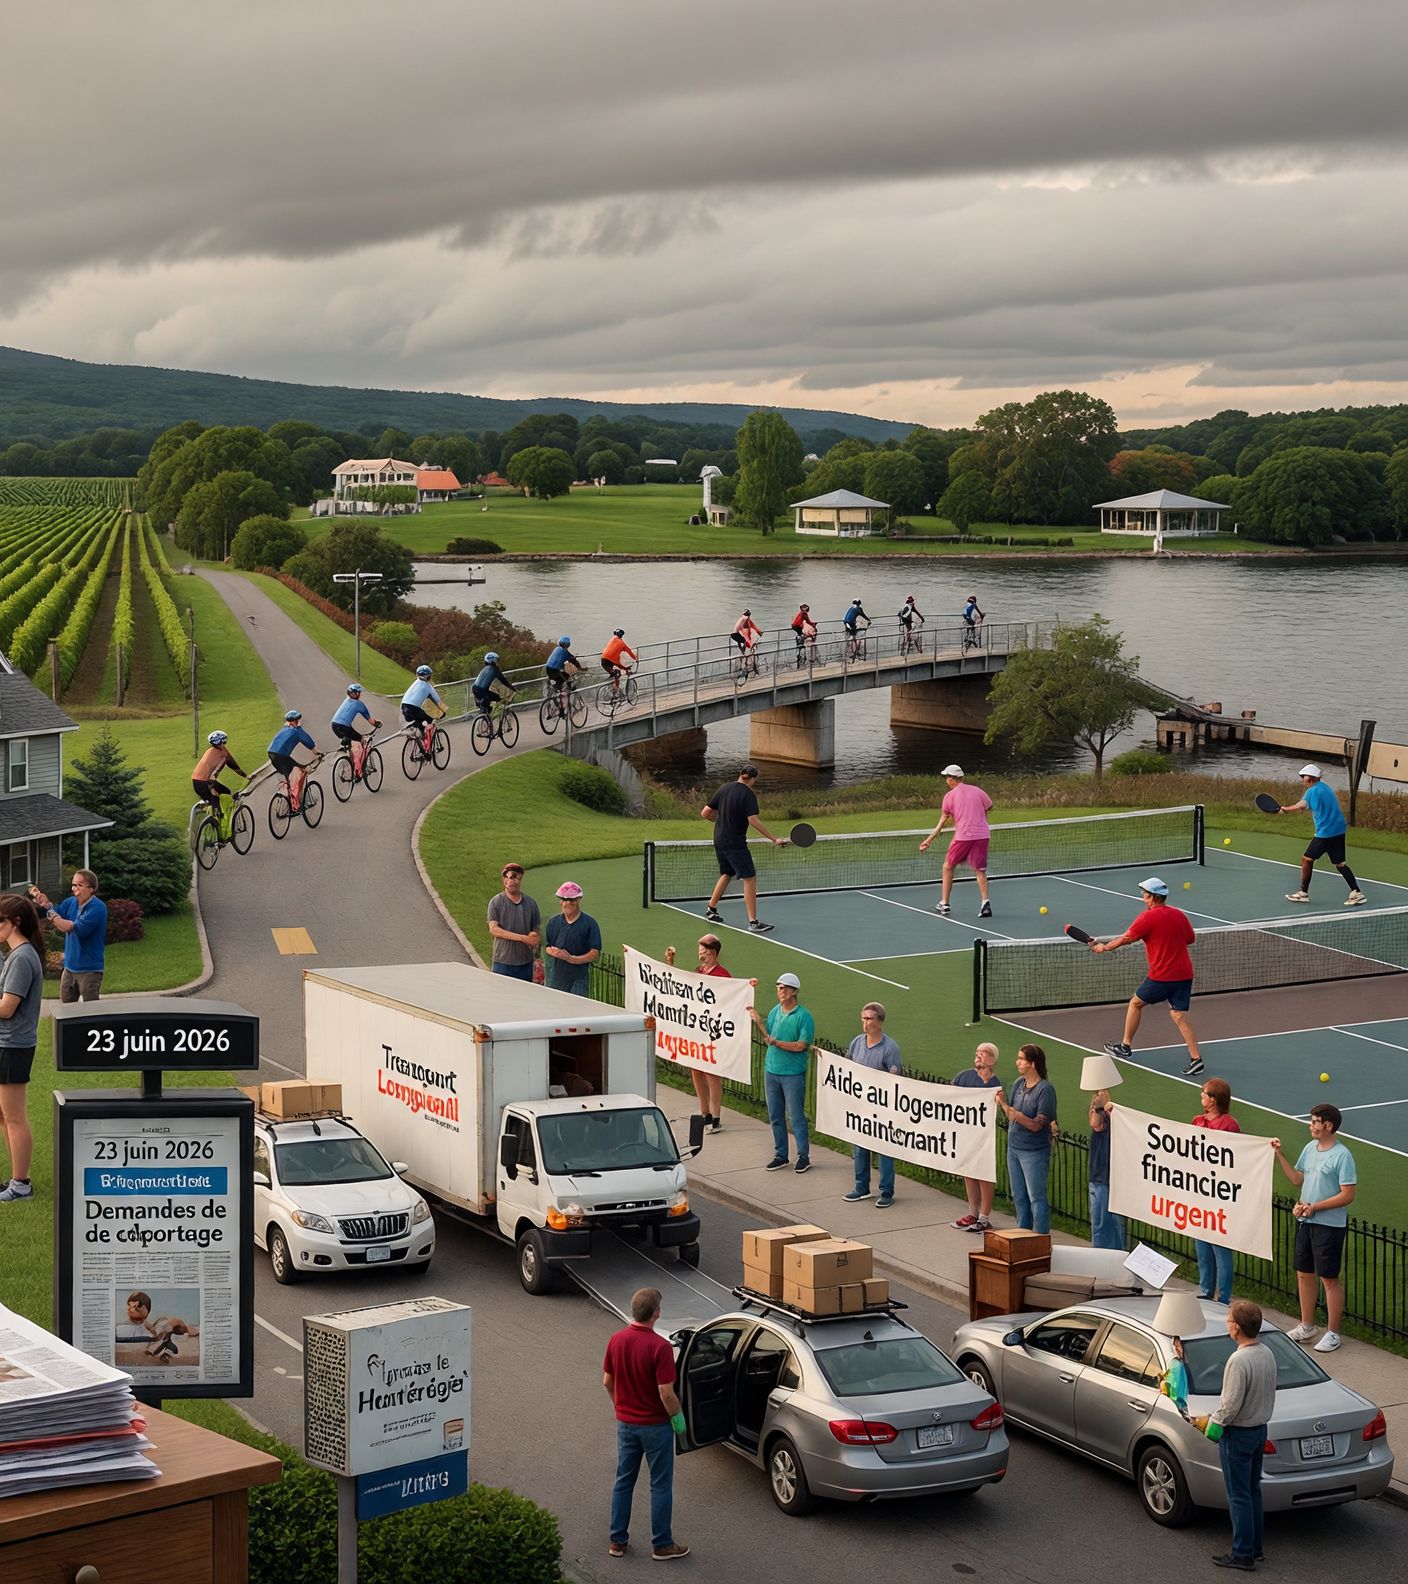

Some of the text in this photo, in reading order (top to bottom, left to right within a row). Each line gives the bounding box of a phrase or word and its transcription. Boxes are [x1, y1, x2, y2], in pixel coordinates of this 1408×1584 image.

[87, 1029, 230, 1059] 23 juin 2026
[823, 1064, 987, 1127] Aide au logement
[94, 1140, 214, 1166] 23 juin 2026
[1147, 1123, 1234, 1168] Soutien
[1141, 1153, 1242, 1202] financier
[85, 1199, 227, 1219] Demandes de
[1151, 1194, 1227, 1235] urgent
[85, 1224, 110, 1243] de
